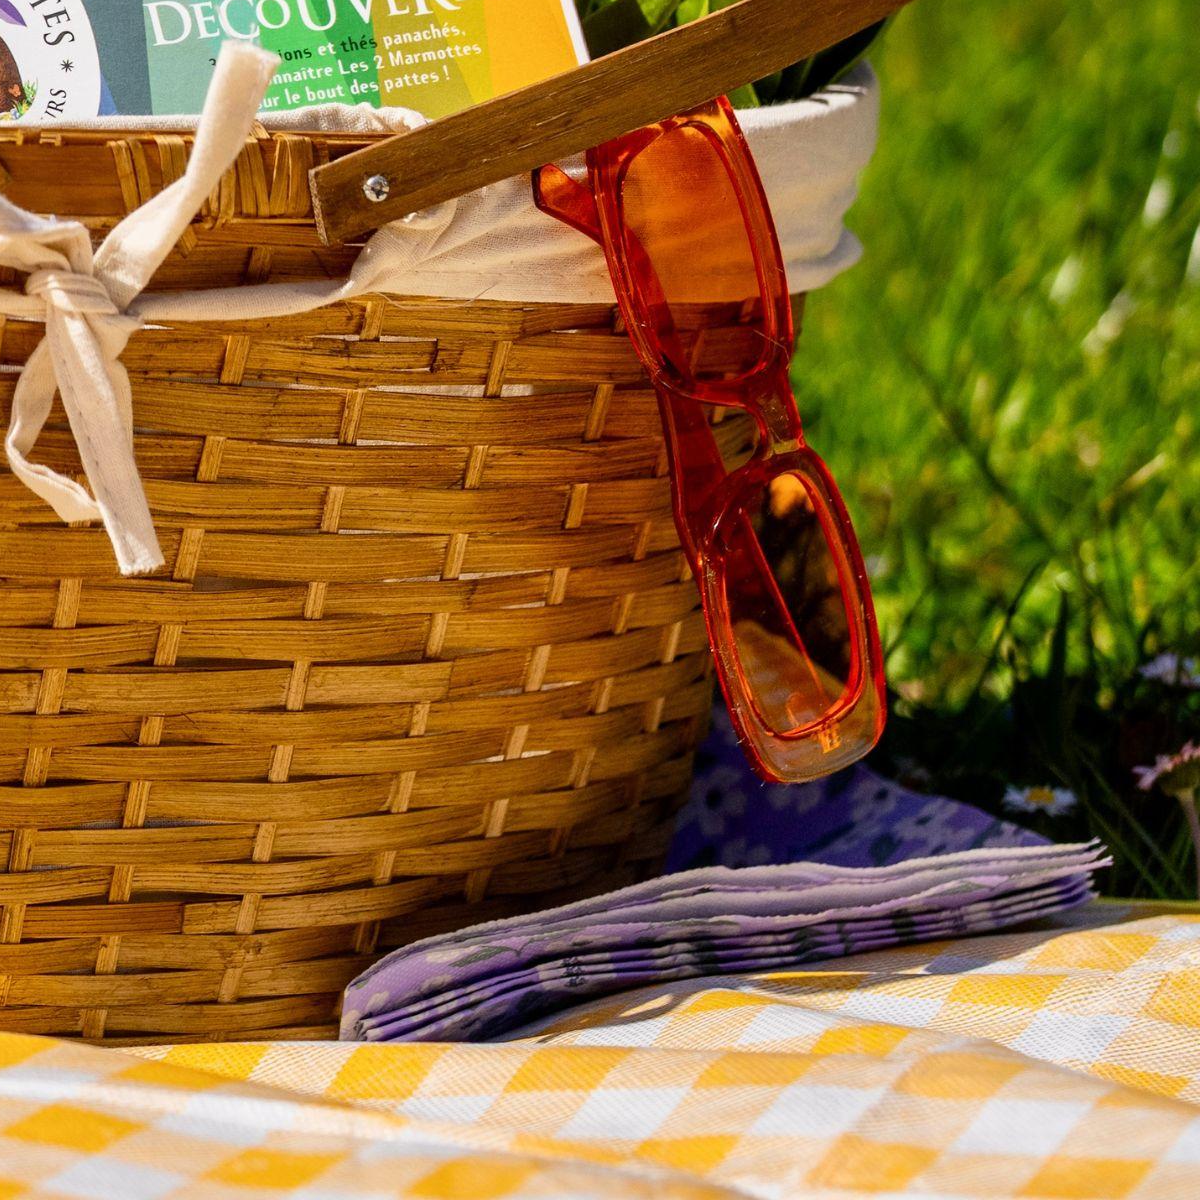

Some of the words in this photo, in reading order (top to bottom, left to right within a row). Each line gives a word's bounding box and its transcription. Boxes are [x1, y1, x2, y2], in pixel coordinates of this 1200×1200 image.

[317, 41, 337, 56] et
[340, 36, 378, 53] thés
[269, 66, 333, 86] nnaître
[338, 56, 369, 76] Les
[374, 55, 384, 70] 2
[389, 44, 483, 67] Marmottes
[285, 88, 301, 105] le
[306, 84, 345, 102] bout
[350, 76, 380, 95] des
[384, 73, 440, 93] pattes
